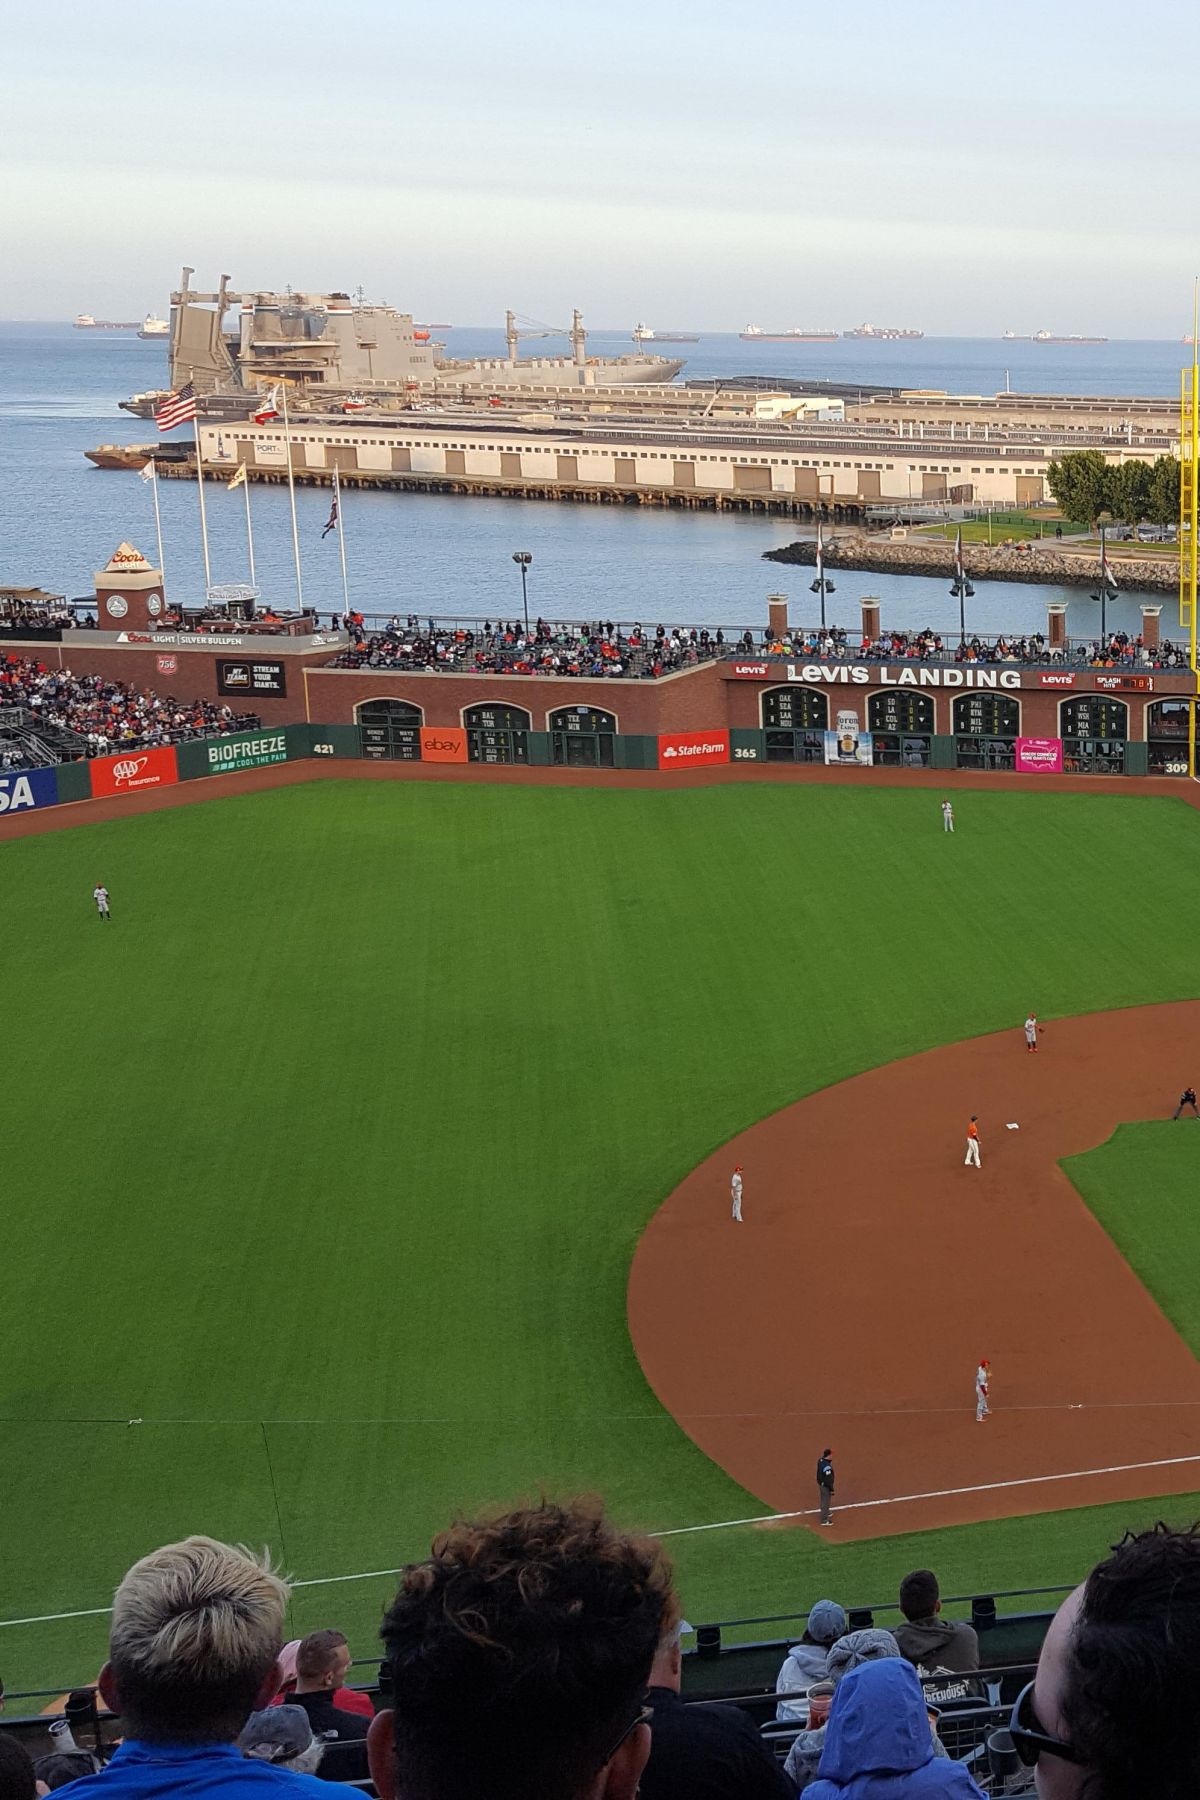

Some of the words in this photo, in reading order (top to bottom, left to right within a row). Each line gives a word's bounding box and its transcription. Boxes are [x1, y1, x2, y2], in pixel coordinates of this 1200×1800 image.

[112, 551, 144, 563] Coors
[160, 660, 176, 668] 756
[880, 667, 1021, 688] LANDING
[313, 744, 334, 754] 421
[424, 737, 461, 753] ebay
[735, 749, 757, 758] 365
[237, 759, 254, 767] COOL
[256, 755, 269, 764] THE
[271, 753, 287, 761] PAIN
[115, 762, 136, 776] AAA
[1166, 764, 1188, 773] 309
[128, 776, 160, 786] Insurance
